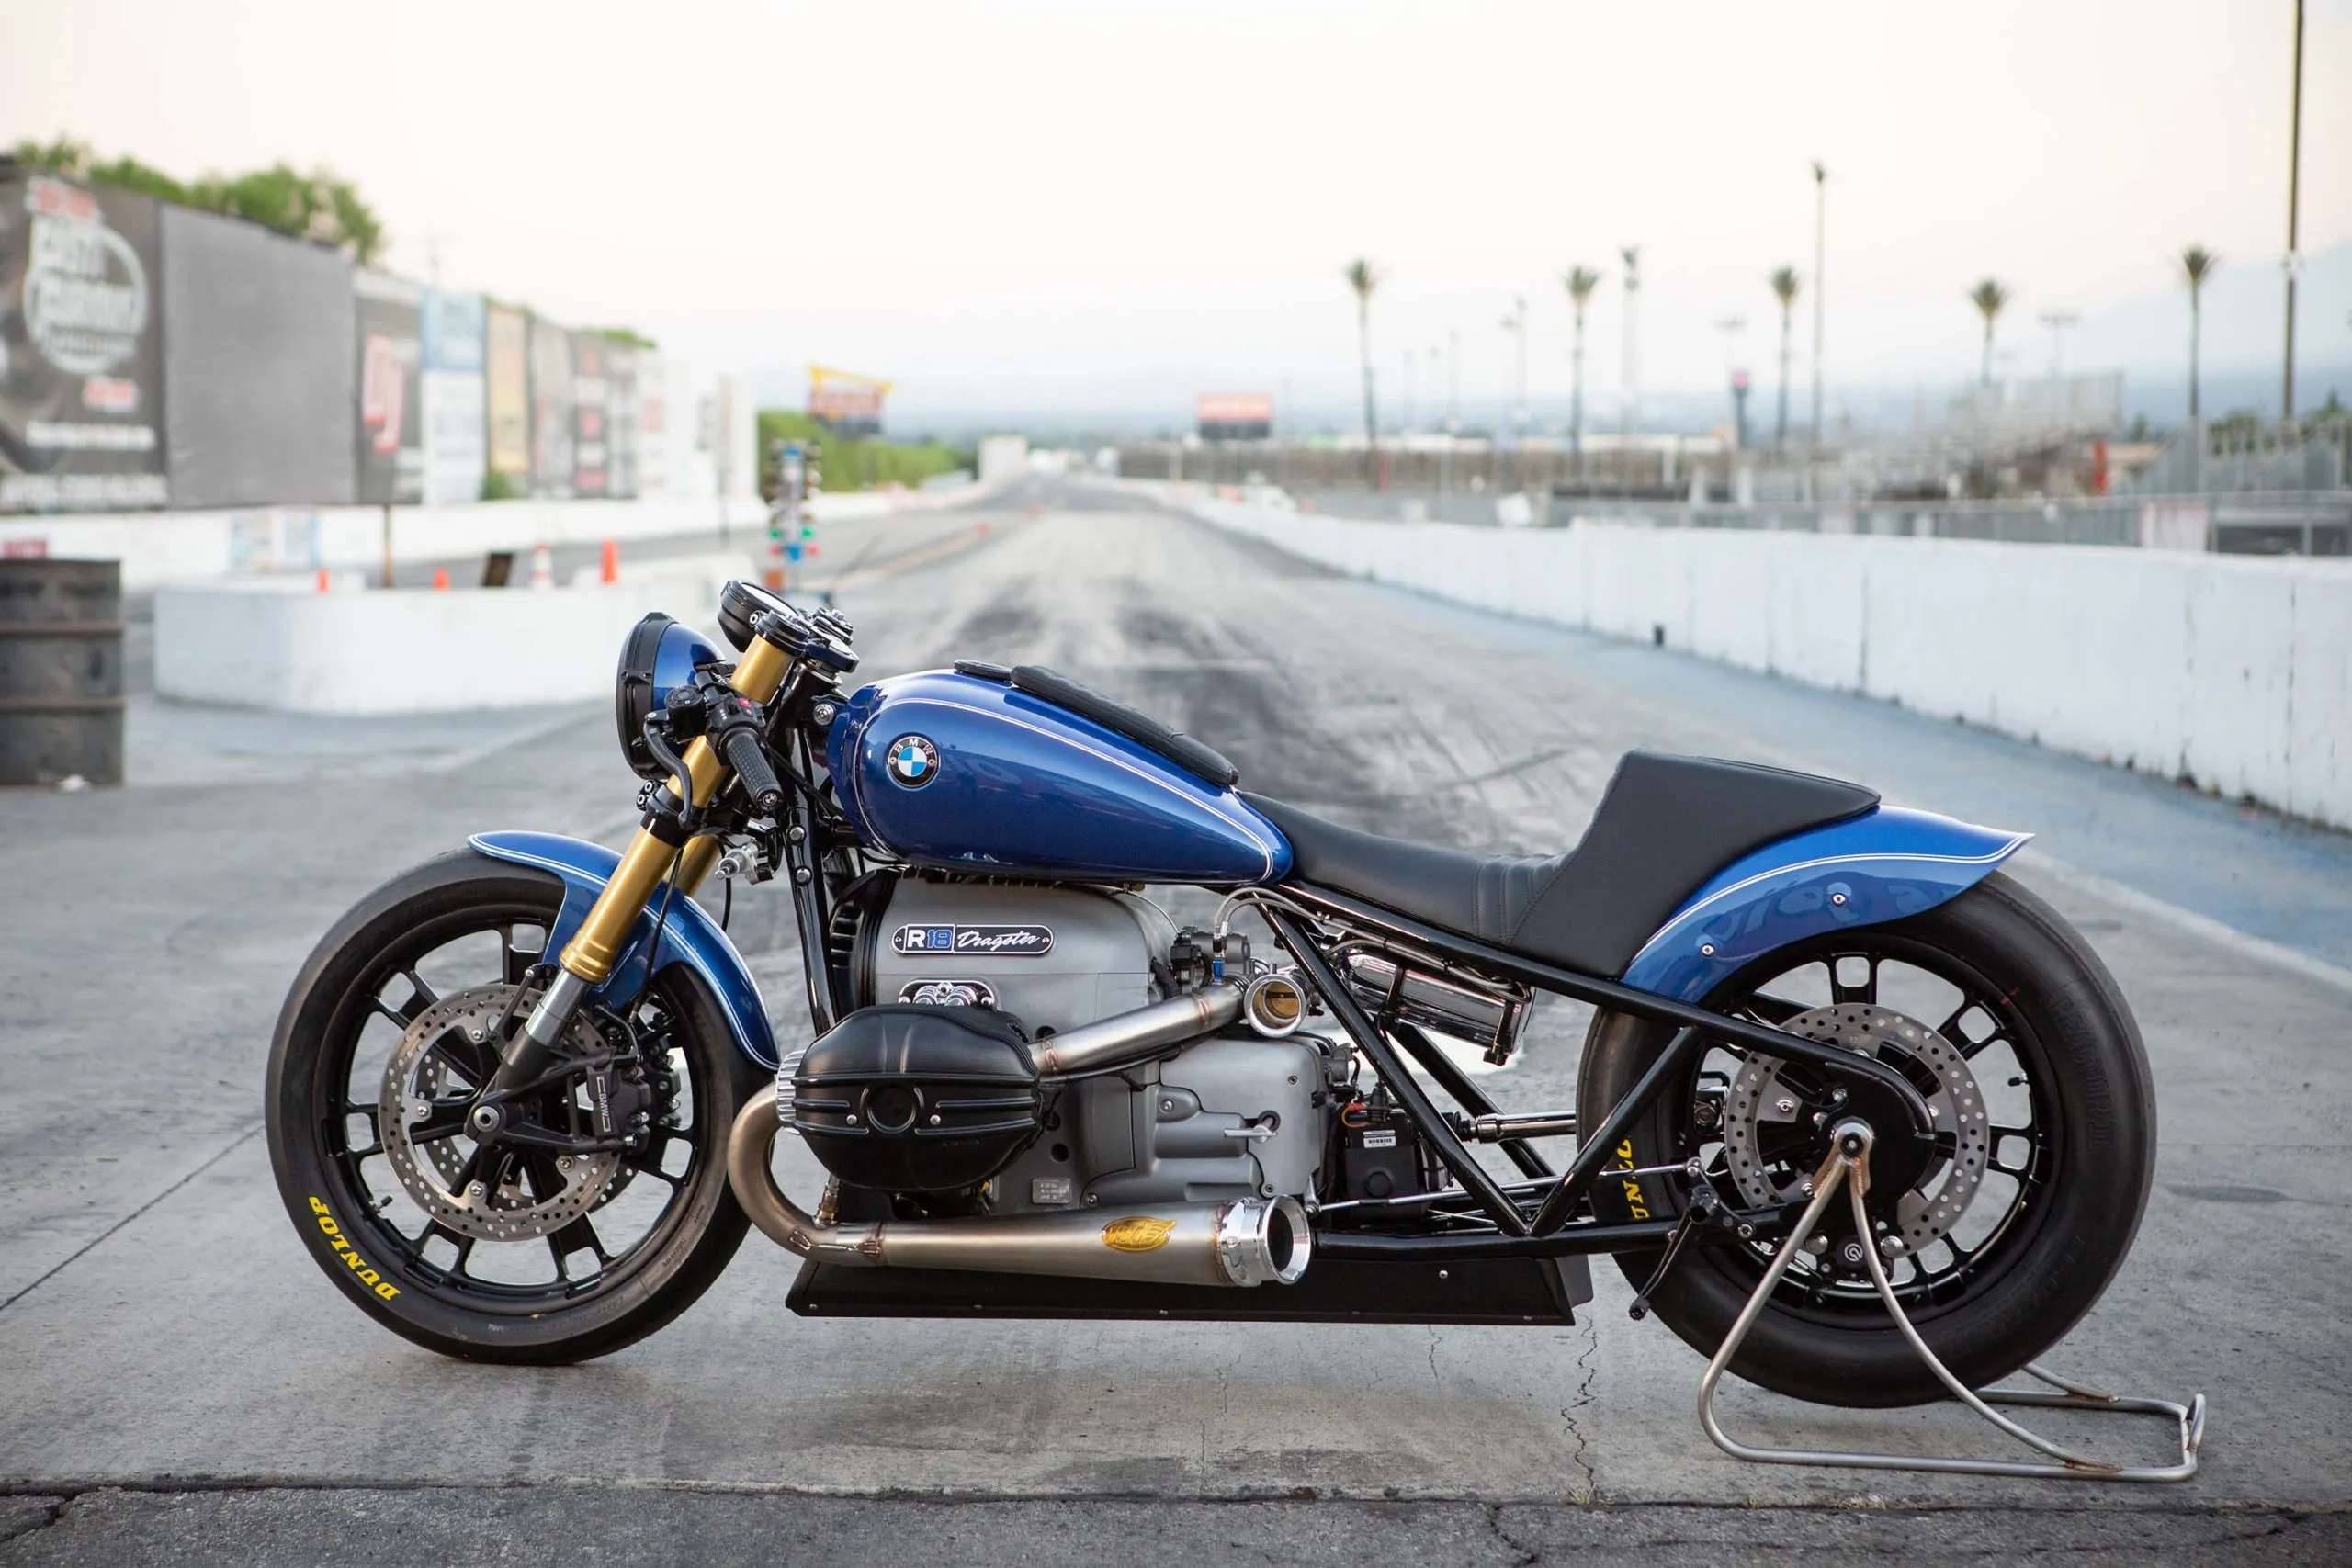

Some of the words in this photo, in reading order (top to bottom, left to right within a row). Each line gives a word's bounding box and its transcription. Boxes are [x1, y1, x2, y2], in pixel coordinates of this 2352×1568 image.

[894, 738, 934, 755] BMW
[907, 930, 953, 949] R18
[956, 930, 1041, 952] Dragster
[599, 1093, 610, 1117] BMW
[1616, 1138, 1651, 1220] UNLO
[308, 1196, 401, 1301] DUNLOP
